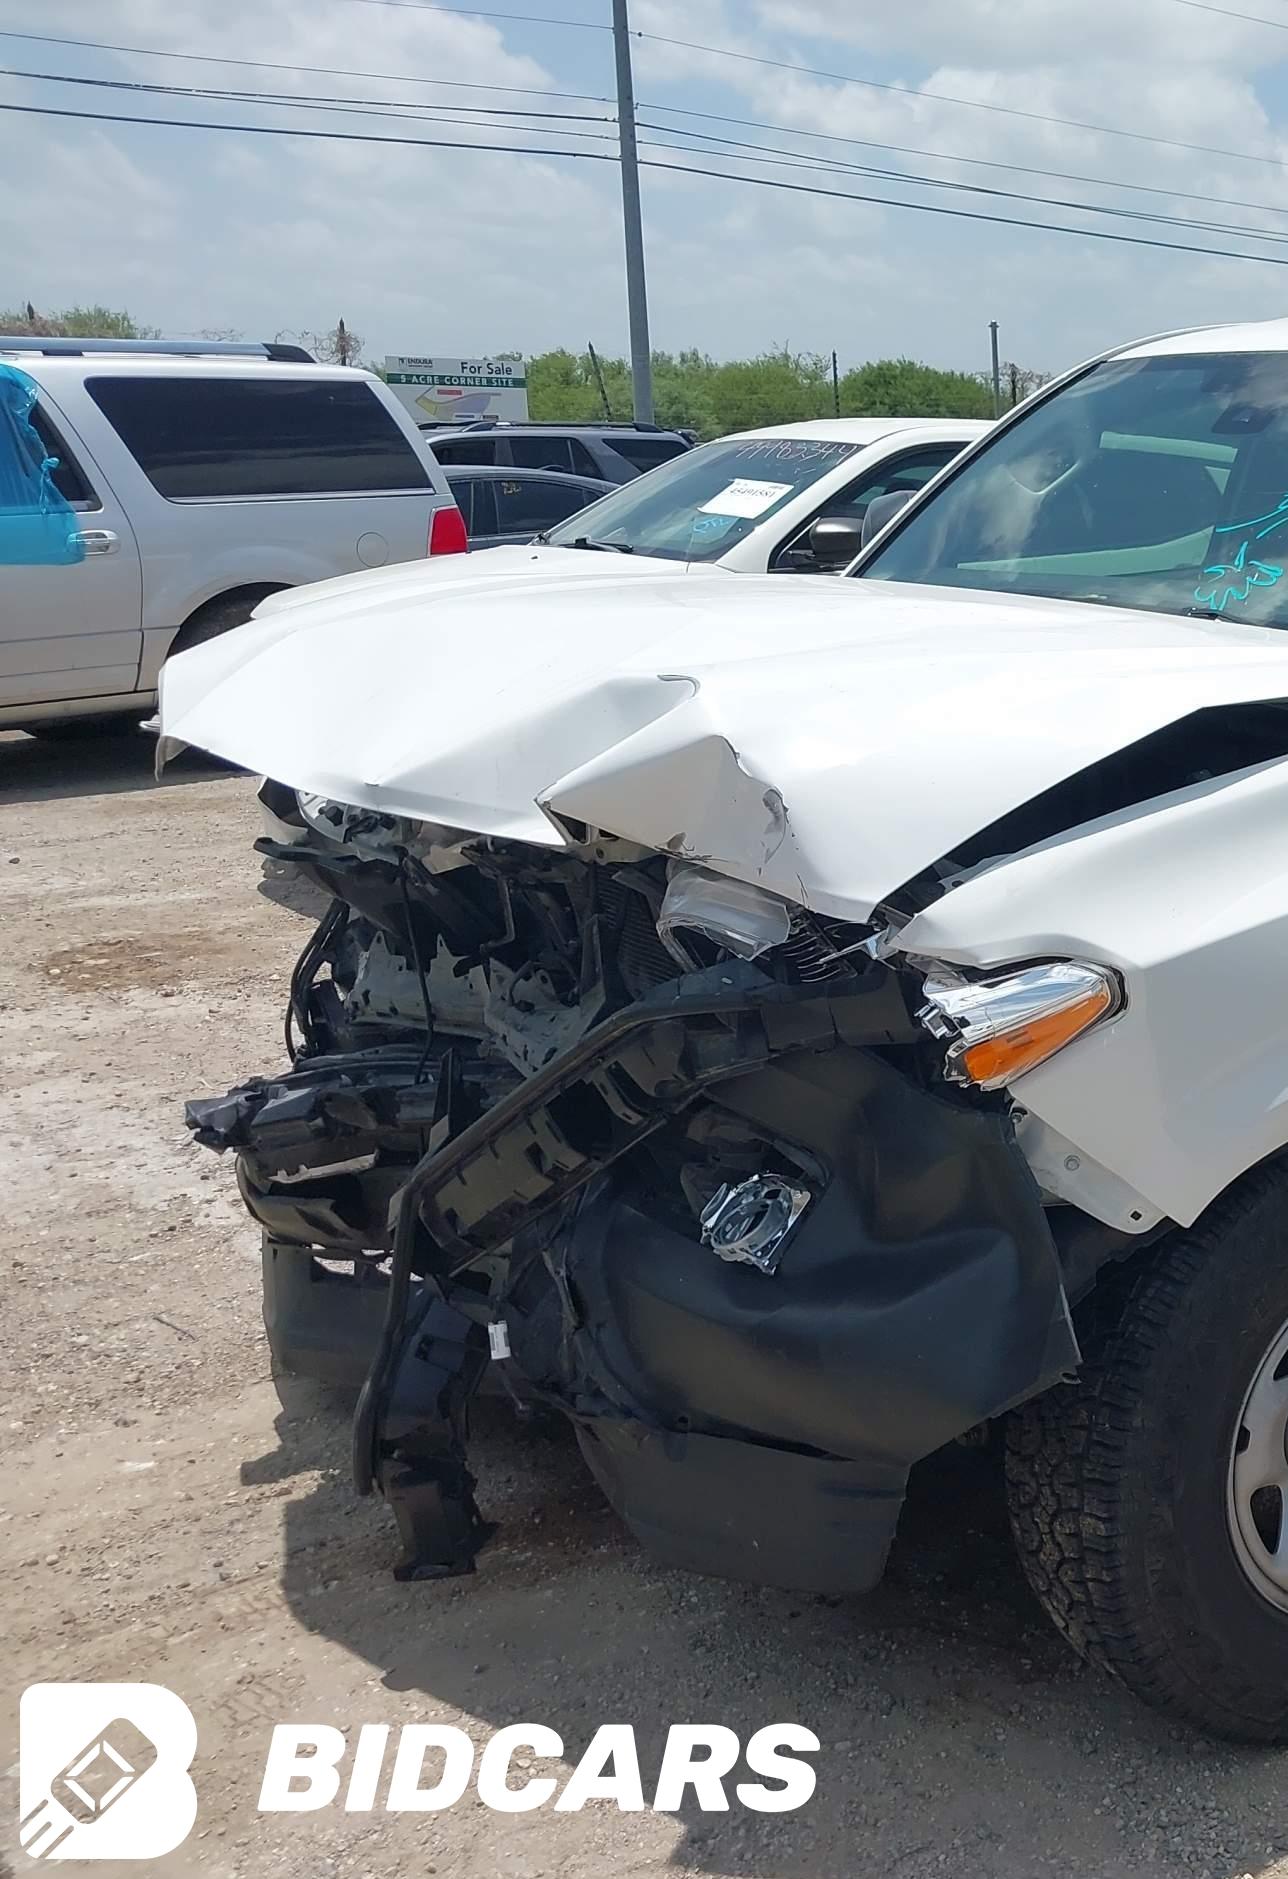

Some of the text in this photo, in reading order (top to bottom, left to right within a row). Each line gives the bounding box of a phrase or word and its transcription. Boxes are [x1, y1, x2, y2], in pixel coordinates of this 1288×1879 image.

[461, 362, 513, 375] For Sale
[444, 376, 487, 386] CORNER
[492, 378, 514, 387] SITE
